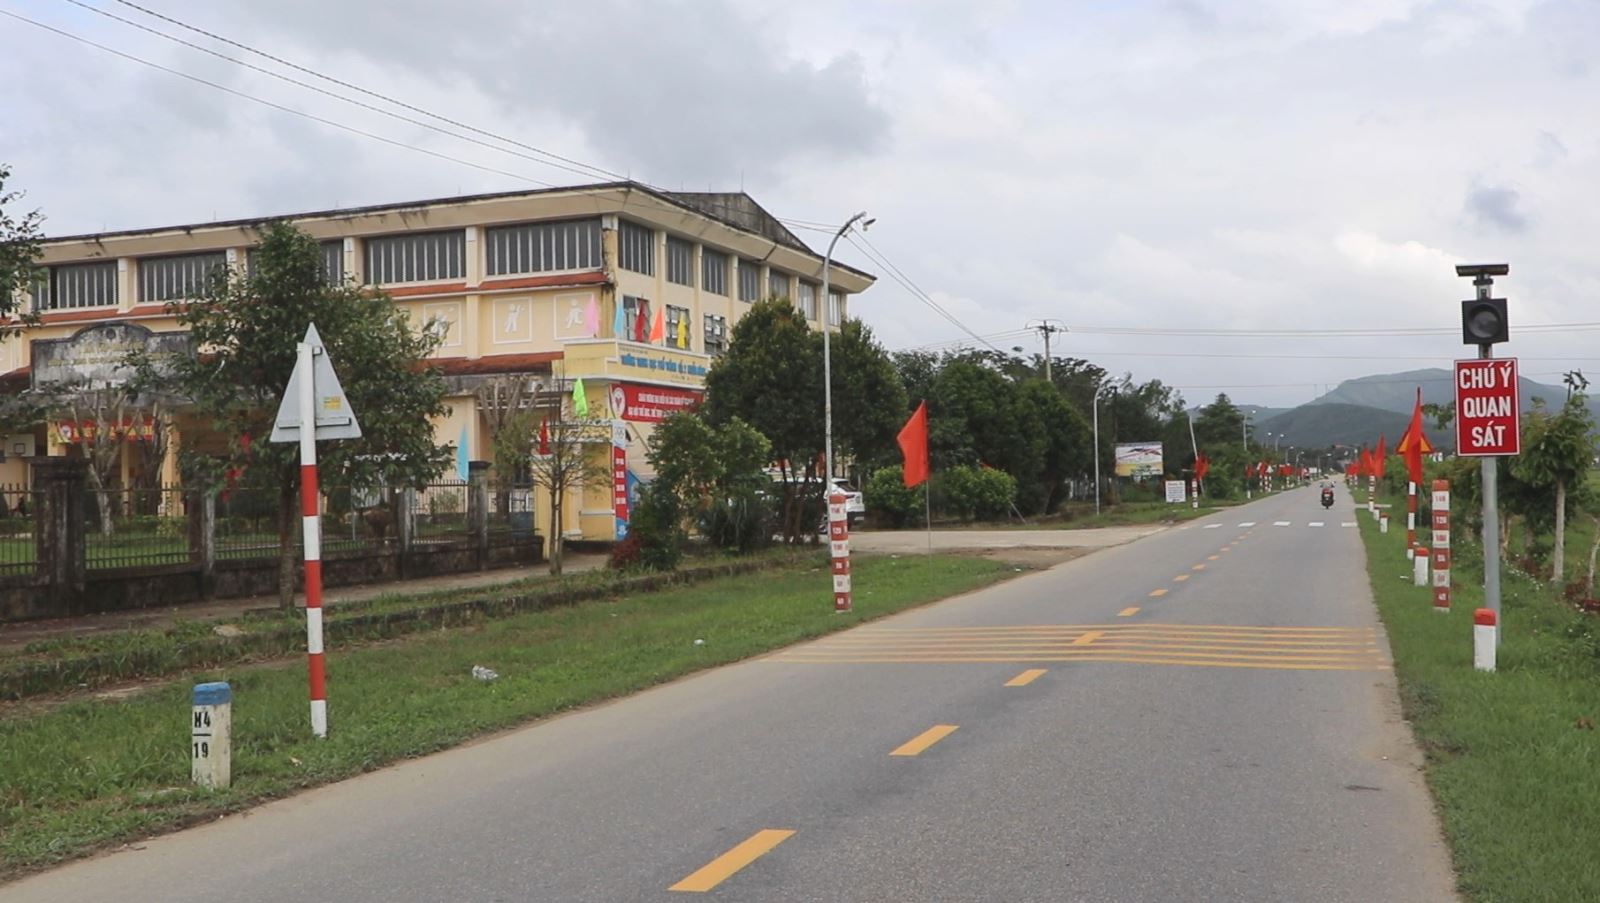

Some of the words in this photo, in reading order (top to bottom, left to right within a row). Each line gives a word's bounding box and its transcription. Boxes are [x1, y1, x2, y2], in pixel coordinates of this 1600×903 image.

[1459, 362, 1496, 389] CHÚ
[1500, 361, 1512, 388] Ý
[1463, 396, 1511, 418] QUAN
[1471, 420, 1506, 447] SÁT
[194, 711, 211, 728] H4
[193, 743, 208, 758] 19
